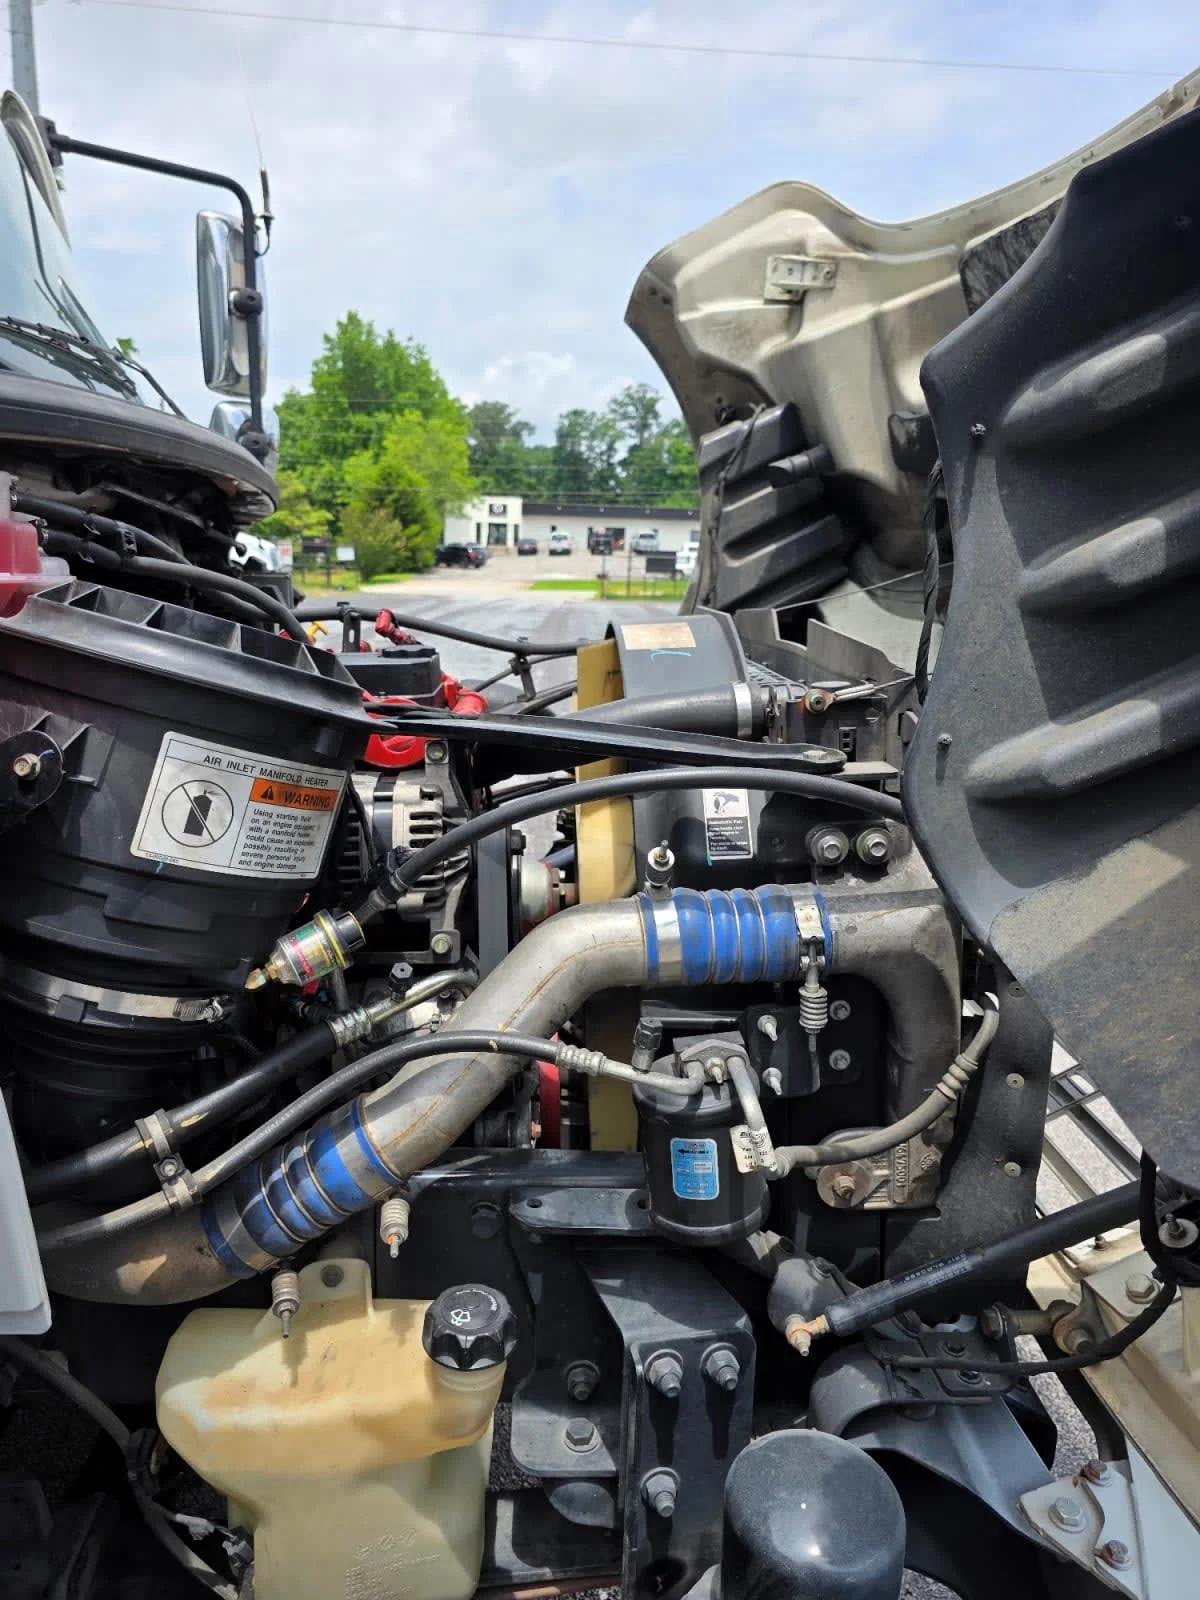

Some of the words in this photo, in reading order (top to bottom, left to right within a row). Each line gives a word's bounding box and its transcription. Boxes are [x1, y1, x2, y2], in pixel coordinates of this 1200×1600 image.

[203, 754, 222, 768] AIR
[226, 760, 256, 775] INLET
[260, 768, 302, 784] MANIFOLD
[304, 777, 328, 787] HEATER
[284, 790, 332, 808] WARNING
[254, 808, 273, 818] Using
[276, 812, 298, 822] starting
[243, 842, 271, 851] possibly
